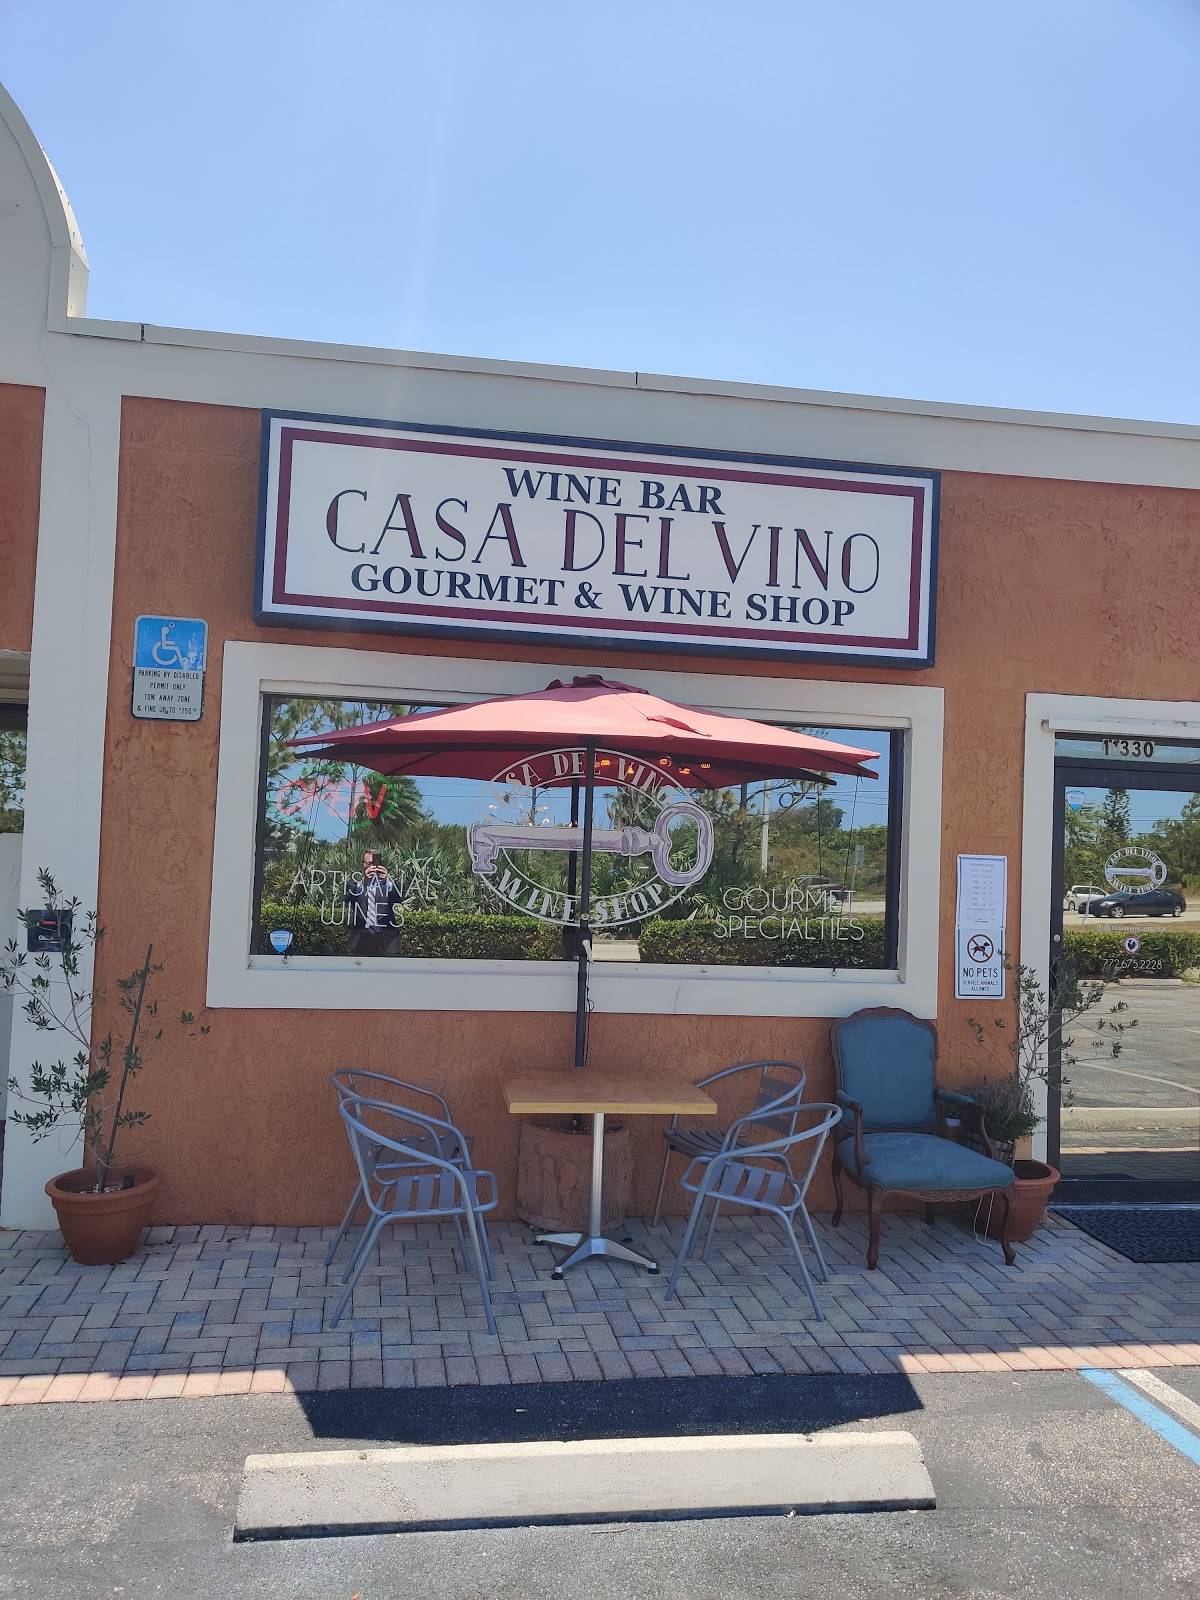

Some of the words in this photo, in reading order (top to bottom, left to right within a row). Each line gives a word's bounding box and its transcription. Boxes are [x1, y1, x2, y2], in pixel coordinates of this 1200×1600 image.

[502, 467, 622, 507] WINE
[638, 479, 726, 515] BAR
[326, 489, 527, 568] CASA
[560, 508, 690, 581] DEL
[711, 520, 880, 594] VINO
[351, 563, 565, 606] GOURMET
[574, 581, 603, 610] &
[617, 583, 732, 619] WINE
[745, 593, 855, 626] SHOP
[150, 682, 170, 690] PERMIT
[174, 672, 200, 680] DISABLED
[288, 867, 438, 901] ARTISANAL
[498, 869, 577, 922] WINE
[594, 882, 664, 922] SHOP
[320, 900, 405, 928] WINES
[723, 887, 857, 914] GOURMET
[713, 914, 865, 941] SPECIALTIES
[962, 967, 974, 978] NO
[976, 967, 998, 978] PETS
